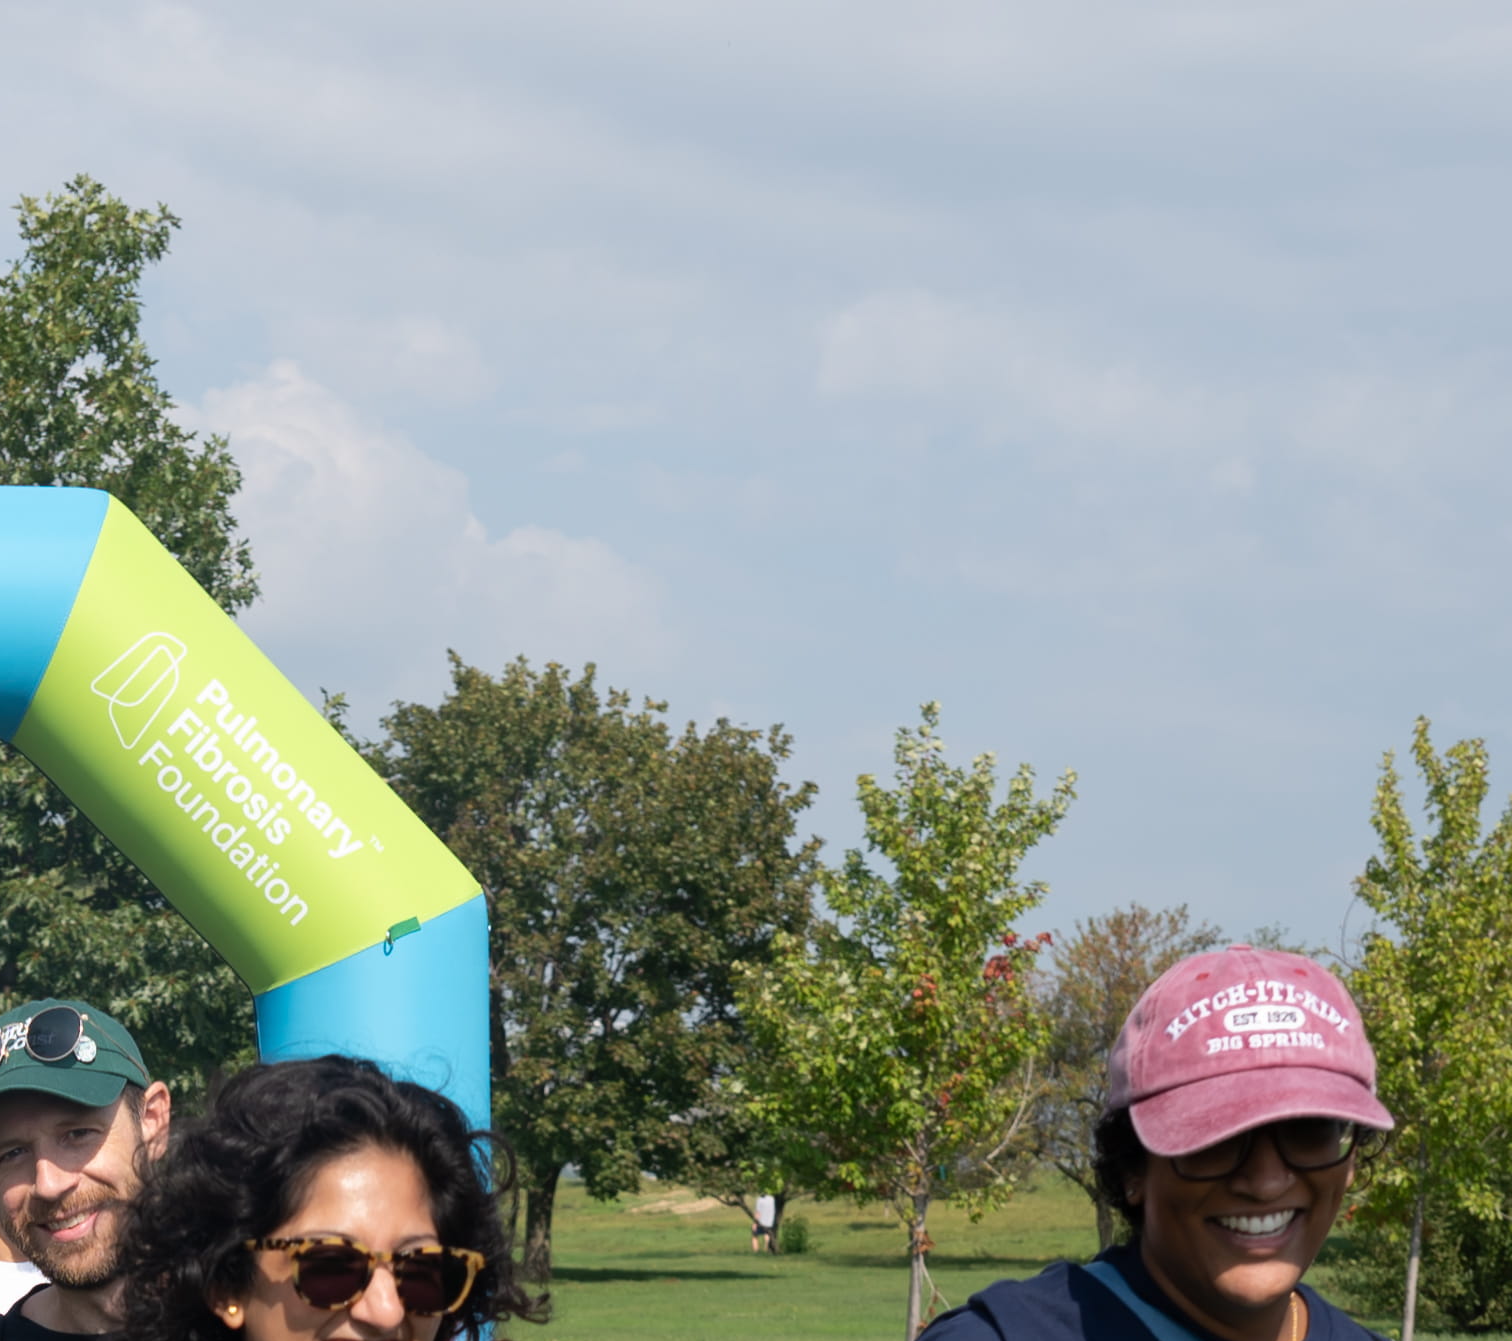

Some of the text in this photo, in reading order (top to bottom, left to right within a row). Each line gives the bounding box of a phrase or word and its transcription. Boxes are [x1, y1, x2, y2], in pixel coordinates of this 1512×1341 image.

[138, 740, 309, 926] Foundation
[167, 708, 291, 845] Fibrosis
[195, 679, 364, 859] Pulmonary
[1207, 1031, 1325, 1055] BIG SPRING
